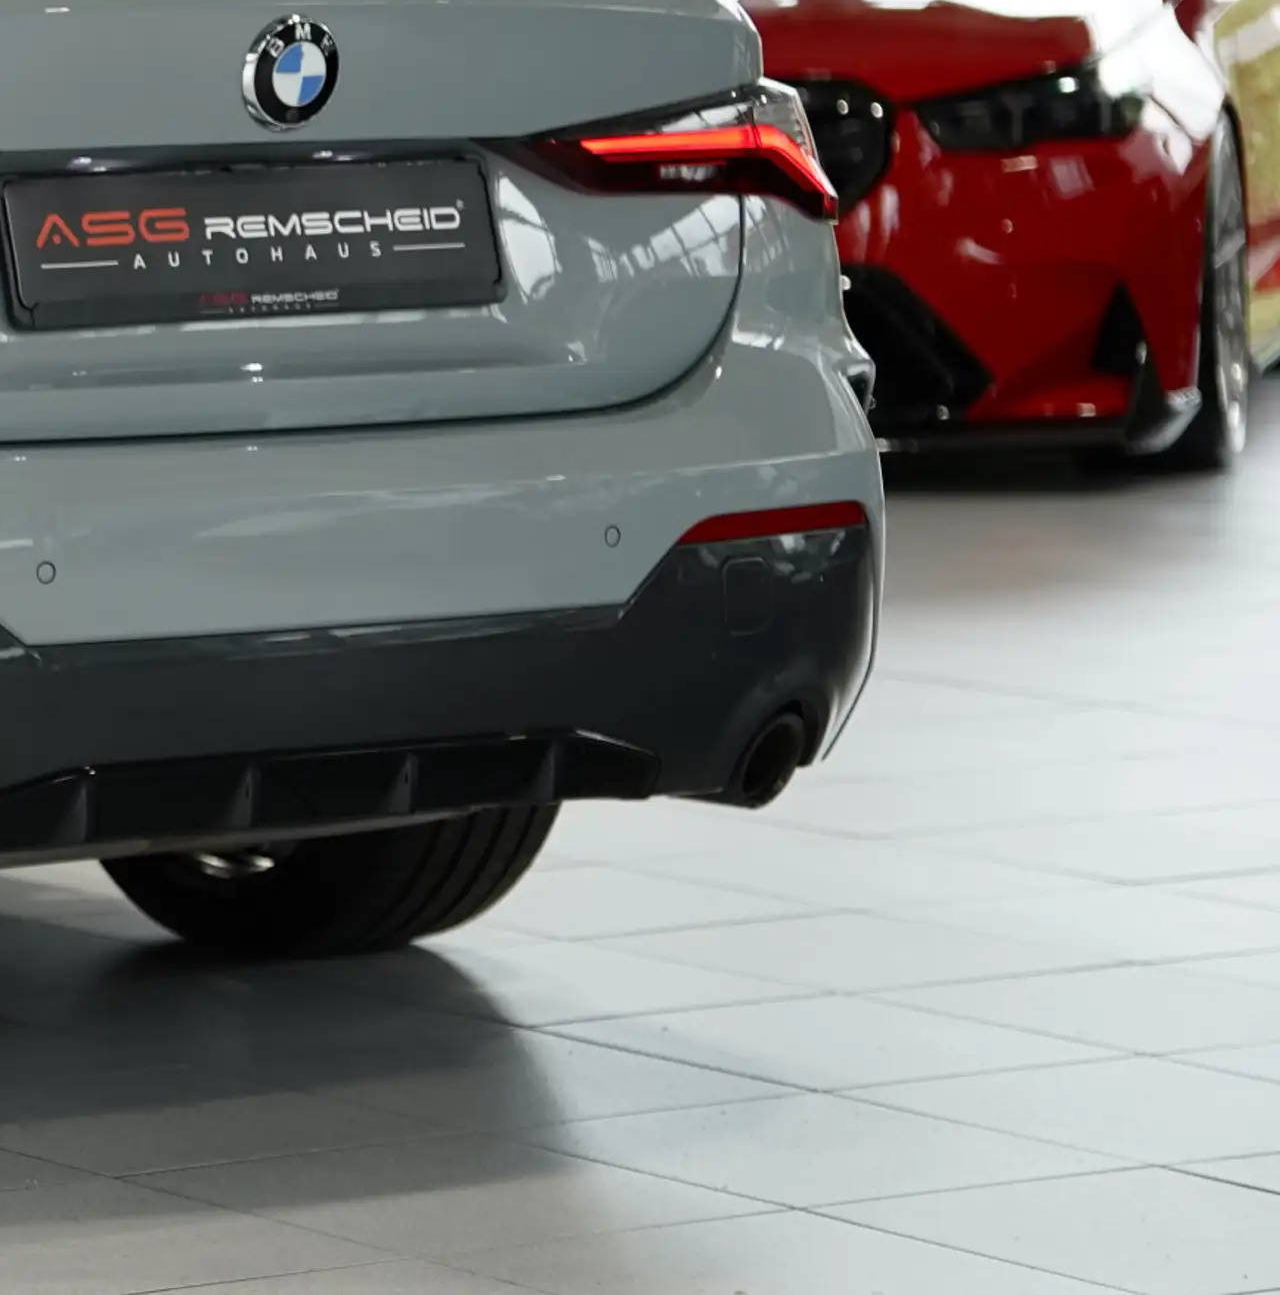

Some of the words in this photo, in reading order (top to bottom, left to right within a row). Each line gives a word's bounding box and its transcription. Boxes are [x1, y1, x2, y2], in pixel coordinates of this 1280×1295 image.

[36, 207, 190, 249] ASG
[204, 206, 461, 240] REMSCHEID
[132, 241, 382, 269] AUTOHAUS
